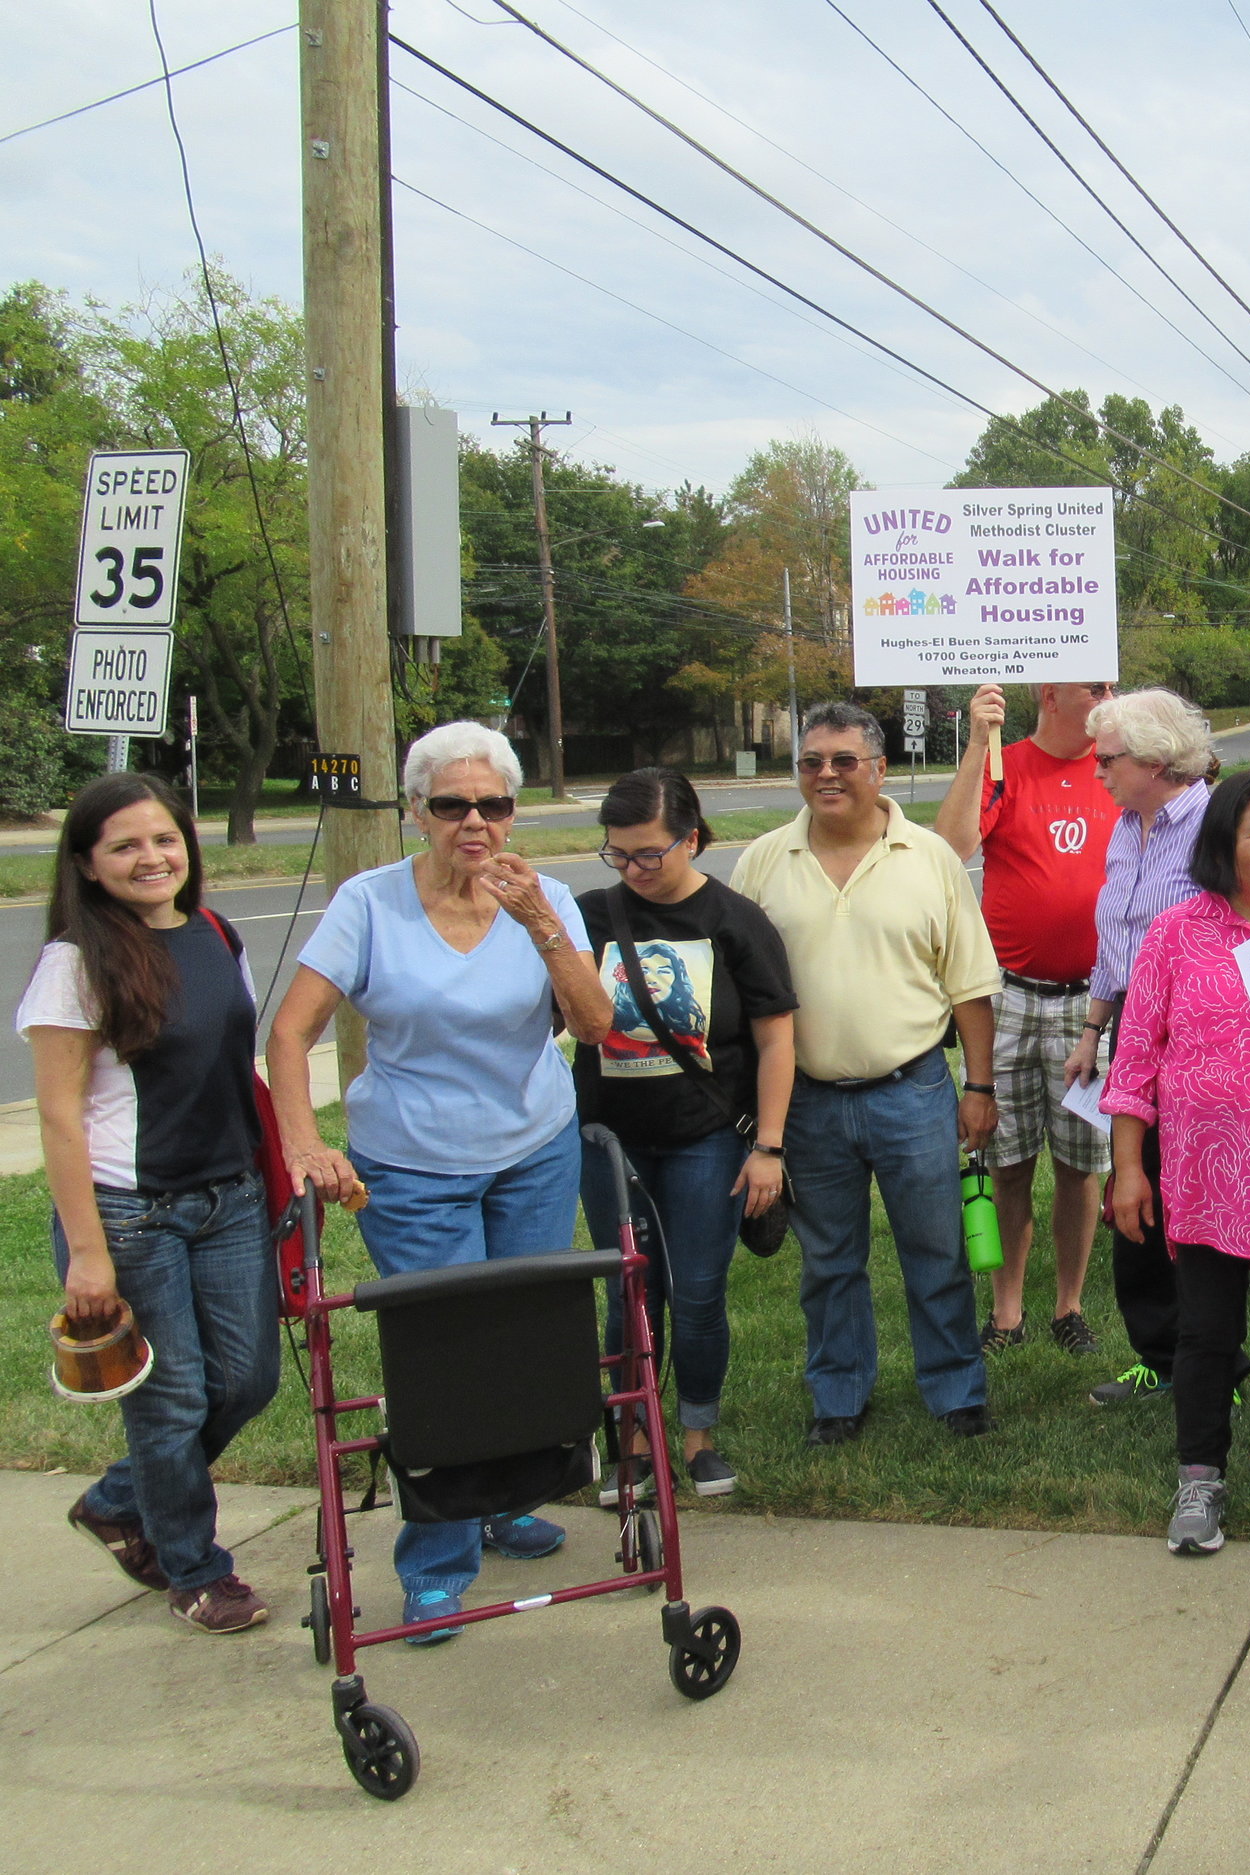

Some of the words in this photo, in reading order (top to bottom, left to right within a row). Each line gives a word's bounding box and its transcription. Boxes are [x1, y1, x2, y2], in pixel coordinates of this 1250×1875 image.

[96, 469, 177, 496] SPEED
[101, 505, 164, 531] LIMIT
[963, 504, 1003, 516] Silver
[1008, 504, 1052, 518] Spring
[1057, 503, 1103, 515] United
[864, 509, 952, 535] UNITED
[970, 525, 1040, 537] Methodist
[1045, 524, 1096, 536] Cluster
[896, 530, 918, 552] for
[864, 552, 953, 566] AFFORDABLE
[978, 549, 1041, 567] Walk
[1049, 549, 1084, 565] for
[90, 546, 164, 609] 35
[878, 568, 940, 581] HOUSING
[966, 577, 1099, 595] Affordable
[980, 604, 1084, 625] Housing
[881, 638, 945, 649] Hughes-El
[949, 637, 980, 646] Buen
[985, 636, 1056, 645] Samaritano
[1060, 635, 1089, 644] UMC
[918, 652, 956, 661] 10700
[960, 651, 1008, 662] Georgia
[1013, 650, 1059, 659] Avenue
[92, 649, 147, 681] PHOTO
[942, 666, 1000, 676] Wheaton,
[1005, 665, 1024, 674] MD
[76, 689, 158, 722] ENFORCED
[905, 704, 924, 712] NORTH
[906, 719, 921, 731] 29
[312, 758, 358, 775] 14270
[311, 775, 319, 790] A
[331, 776, 339, 791] B
[351, 776, 359, 791] C
[634, 1059, 656, 1068] THE
